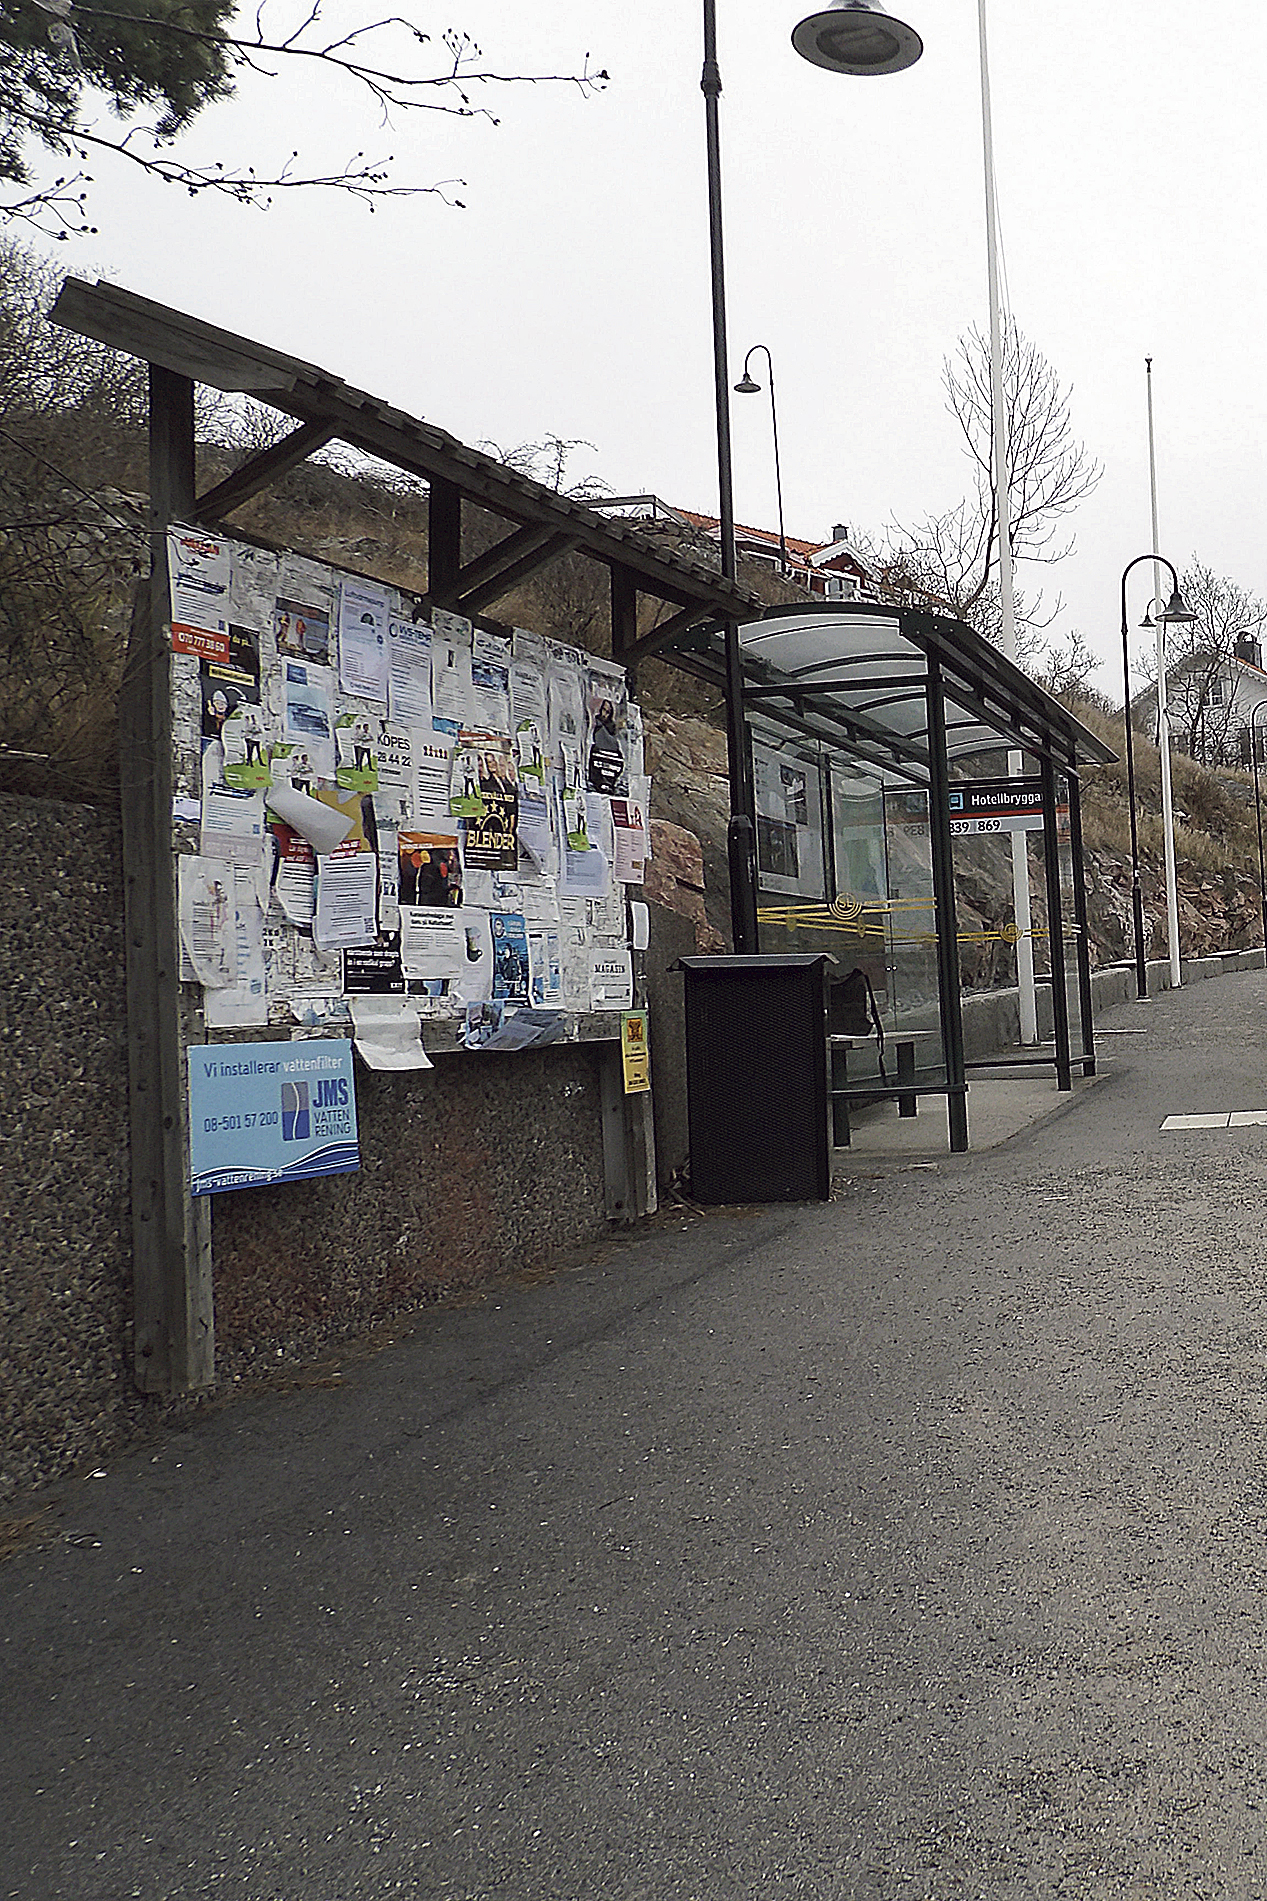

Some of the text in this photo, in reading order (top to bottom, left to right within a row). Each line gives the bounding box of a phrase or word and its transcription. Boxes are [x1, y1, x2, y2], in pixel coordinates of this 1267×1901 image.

[971, 792, 1041, 807] Hotellbrygga
[977, 820, 1000, 832] 869
[467, 831, 515, 851] BLENDER
[203, 1055, 344, 1079] Vi installerar vattenfilter
[312, 1077, 349, 1108] JMS
[203, 1110, 279, 1132] 08-501 57 200
[313, 1108, 350, 1124] VATTEN
[315, 1122, 351, 1137] RENING
